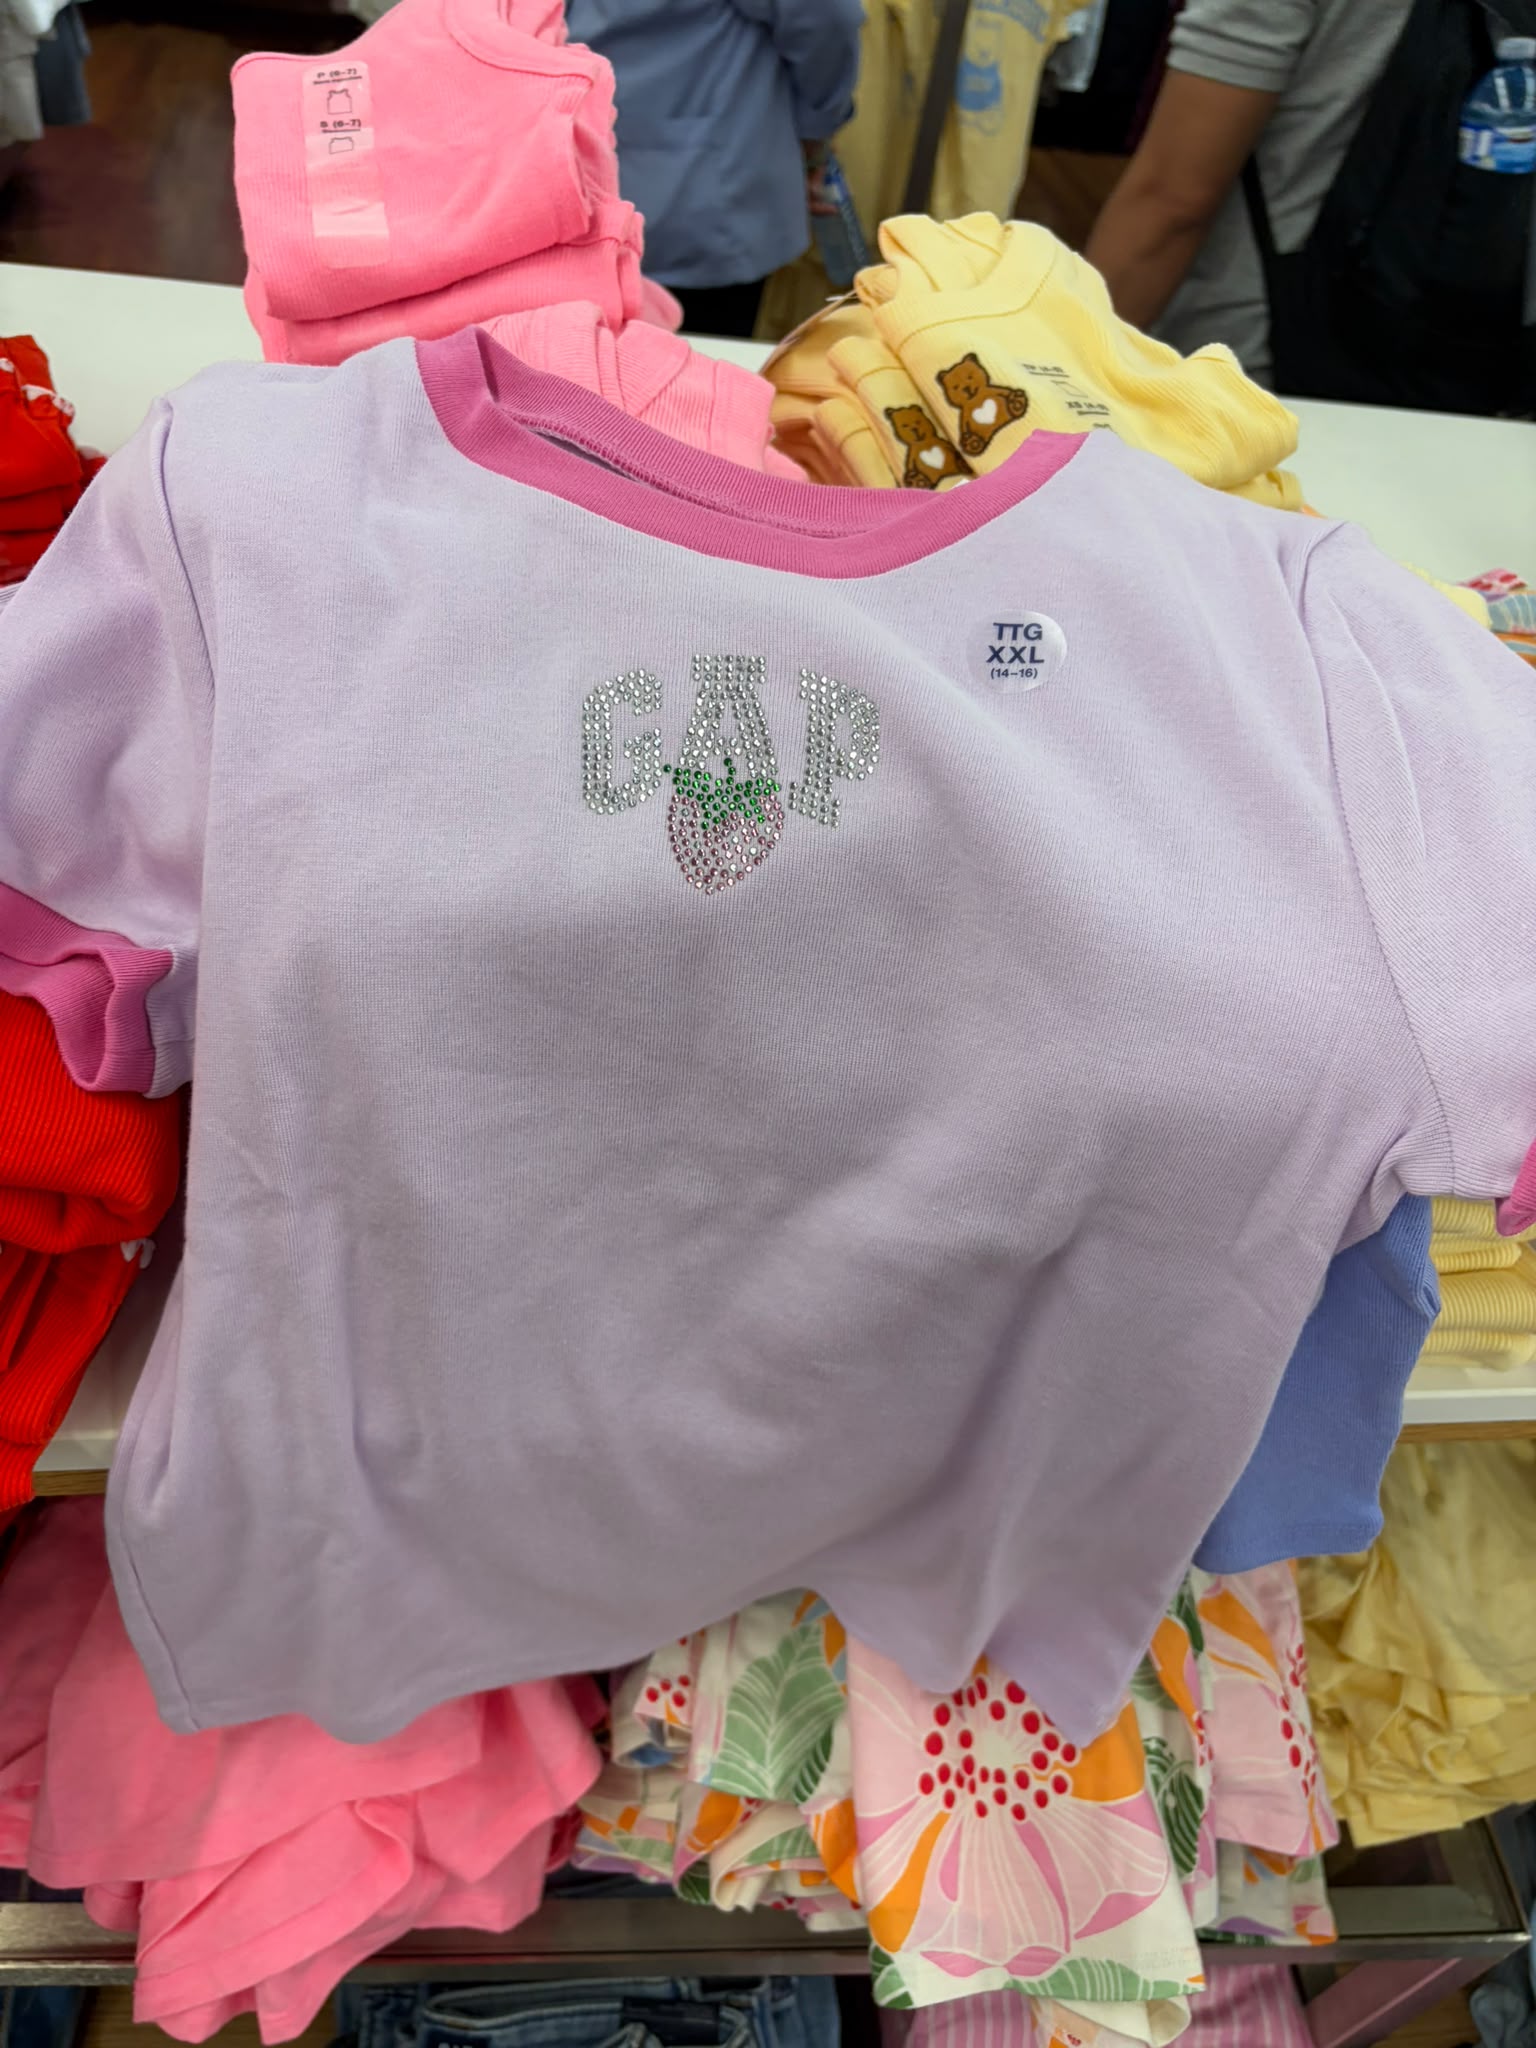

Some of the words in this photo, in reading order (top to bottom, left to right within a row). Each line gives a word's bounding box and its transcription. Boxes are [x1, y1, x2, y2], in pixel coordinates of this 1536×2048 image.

[993, 622, 1043, 641] TTG
[986, 645, 1045, 664] XXL
[582, 653, 882, 832] GAP
